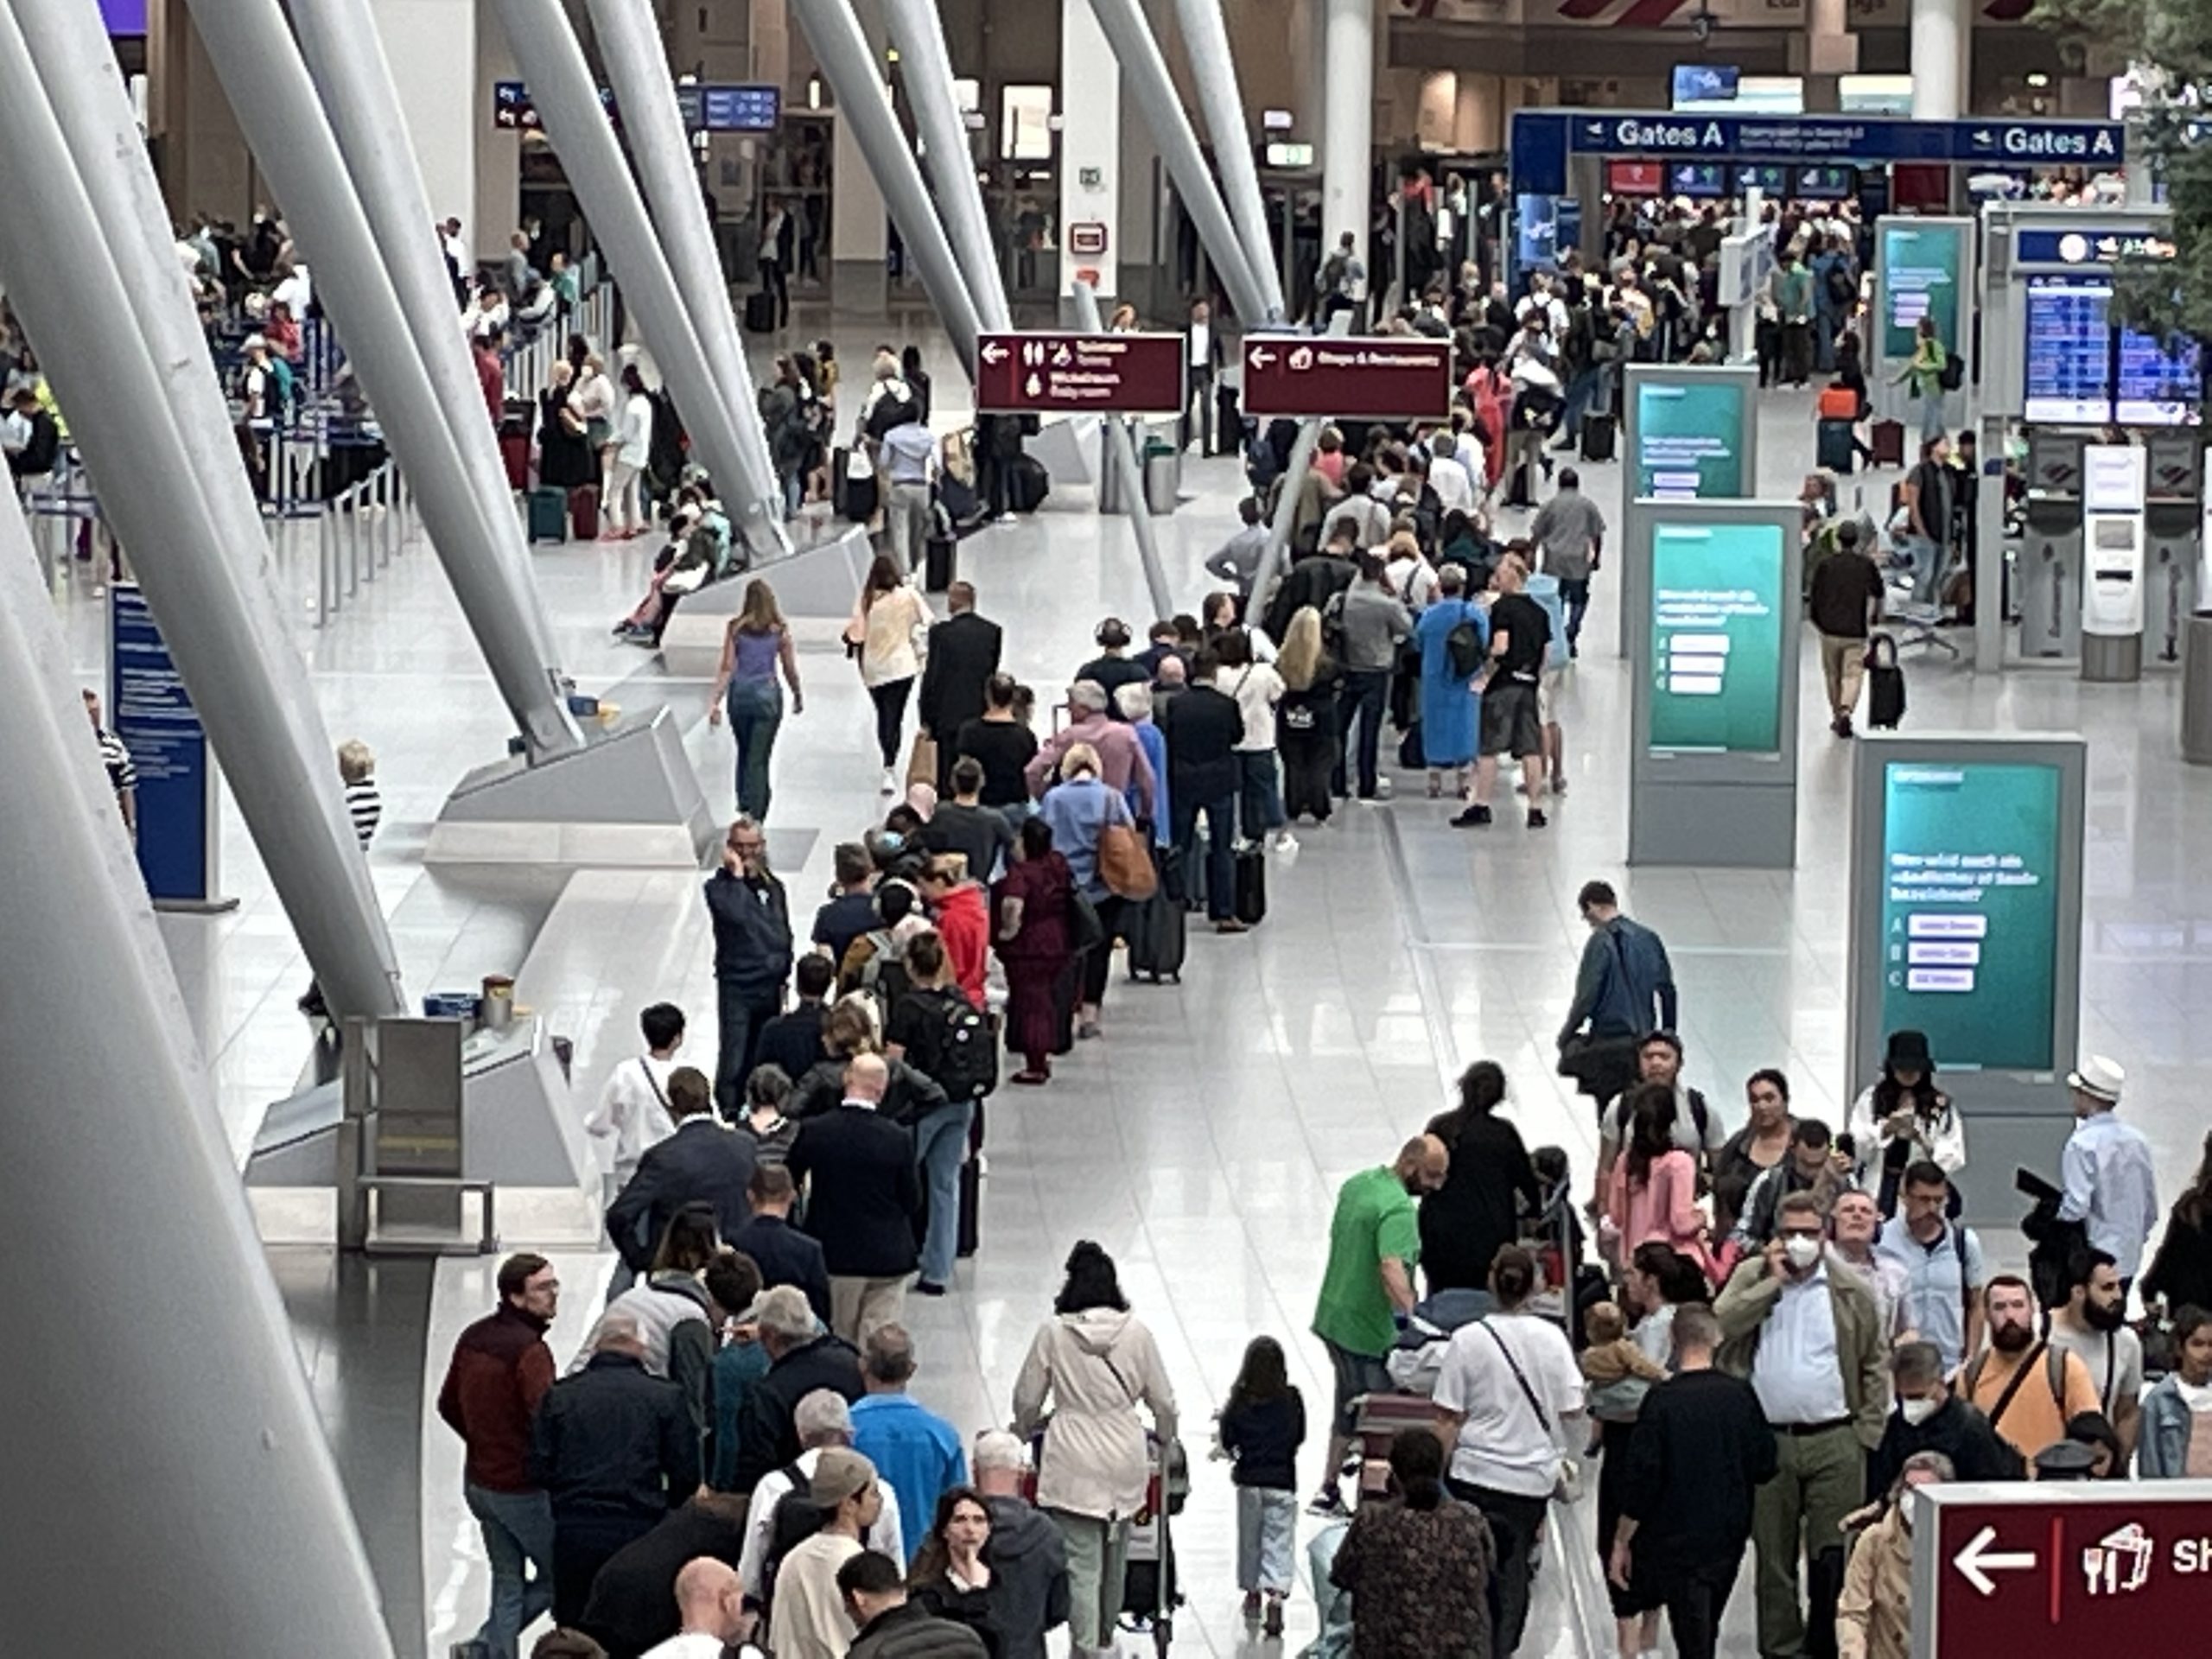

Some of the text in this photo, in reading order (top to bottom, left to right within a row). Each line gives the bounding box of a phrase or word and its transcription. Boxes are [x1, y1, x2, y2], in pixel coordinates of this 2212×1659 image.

[1617, 119, 1697, 146] Gates
[1701, 122, 1724, 147] A
[2005, 127, 2114, 156] Gates A
[1891, 917, 1902, 932] A
[1888, 969, 1902, 987] C
